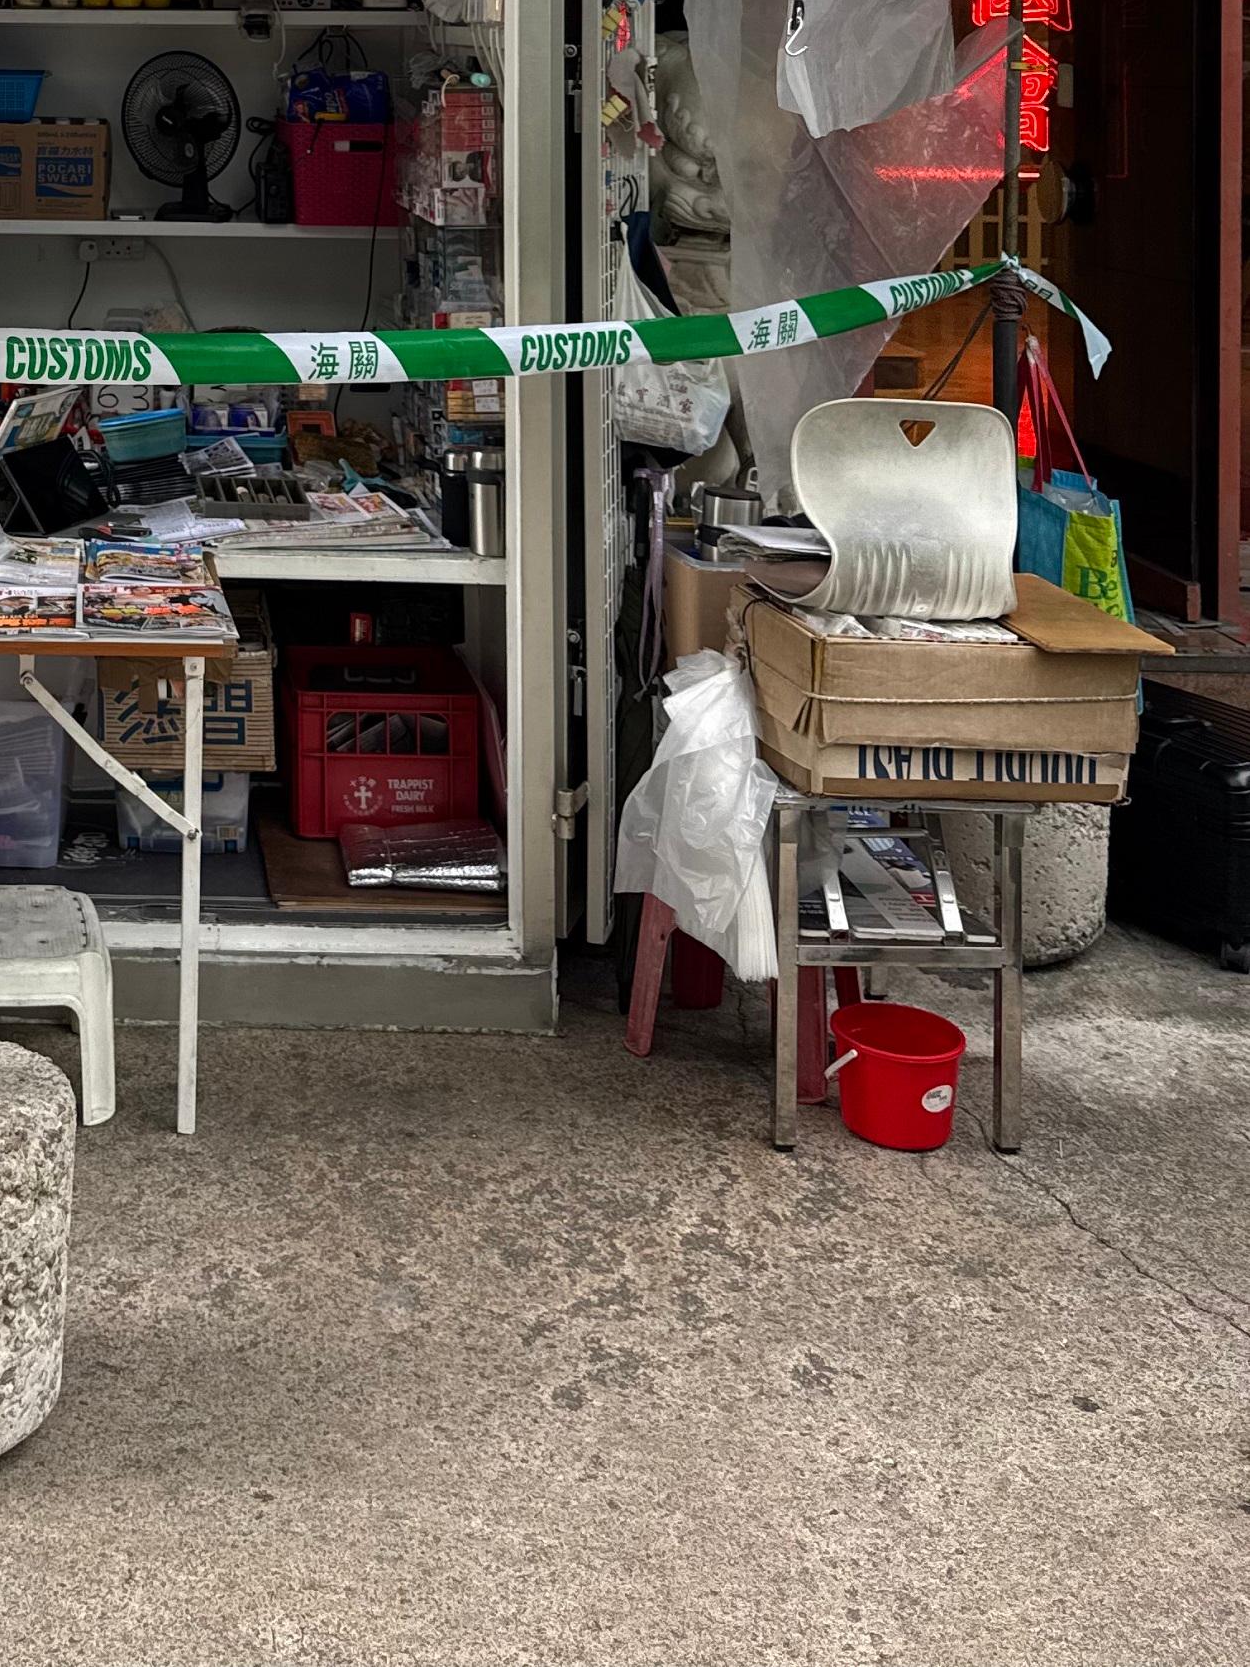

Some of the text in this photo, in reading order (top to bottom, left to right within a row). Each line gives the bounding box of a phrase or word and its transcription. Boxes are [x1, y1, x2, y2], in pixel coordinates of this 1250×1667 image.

[37, 164, 92, 174] POCARI
[37, 174, 86, 183] SWEAT
[748, 309, 799, 350] 海關
[520, 328, 633, 372] CUSTOMS
[5, 335, 152, 381] CUSTOMS
[308, 340, 378, 380] 海關
[387, 779, 435, 791] TRAPPIST
[395, 790, 426, 801] DAIRY
[390, 804, 415, 814] FRESH
[415, 804, 436, 814] MILK
